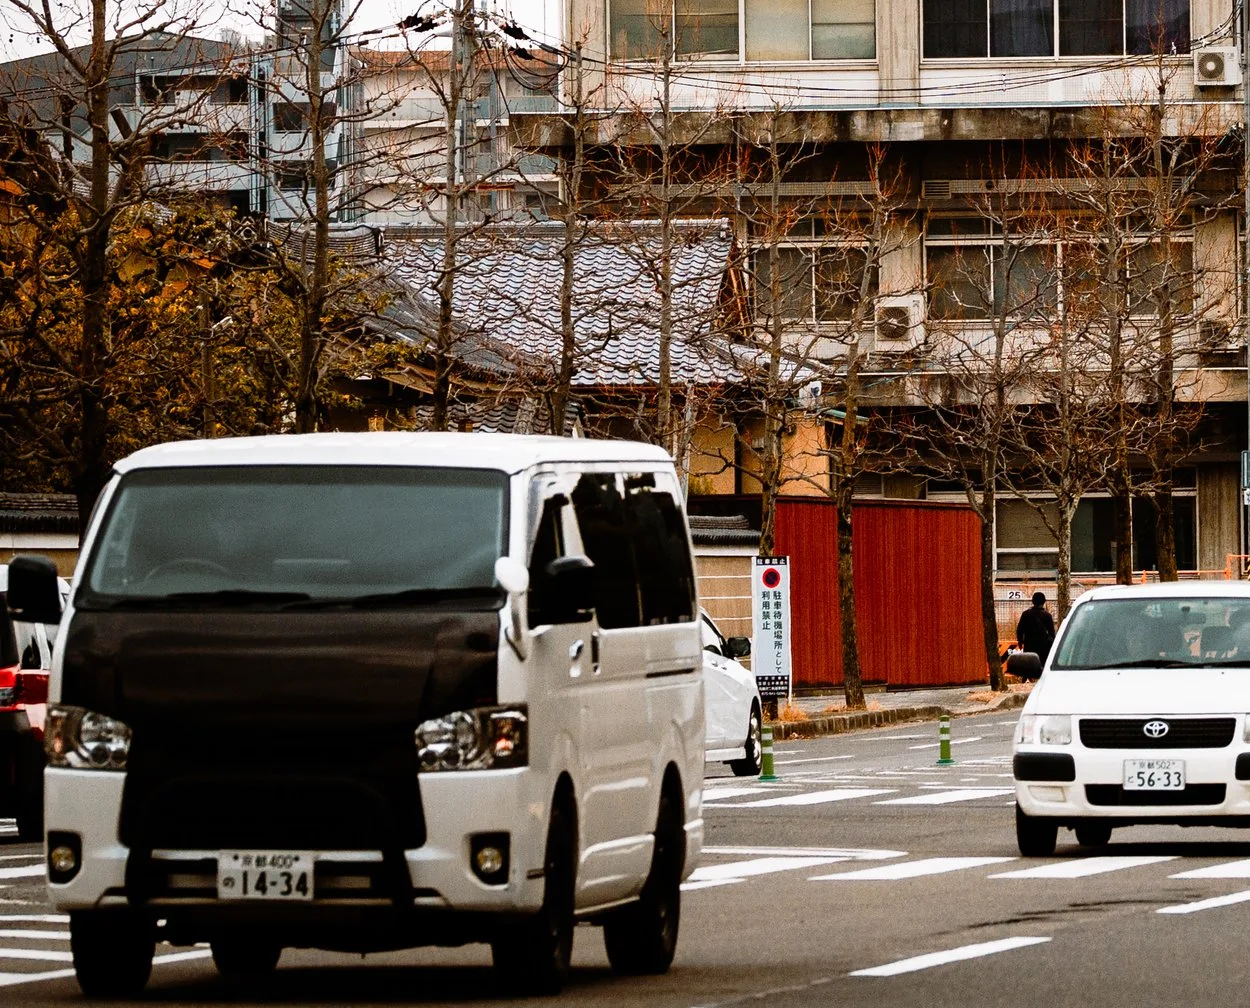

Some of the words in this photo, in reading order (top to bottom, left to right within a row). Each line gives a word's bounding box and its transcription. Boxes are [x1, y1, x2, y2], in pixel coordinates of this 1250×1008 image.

[1008, 591, 1021, 599] 25
[761, 591, 771, 631] 利用禁止
[773, 591, 783, 674] 駐車待機場所として
[1136, 771, 1182, 788] 56-33
[242, 870, 309, 897] 14-34
